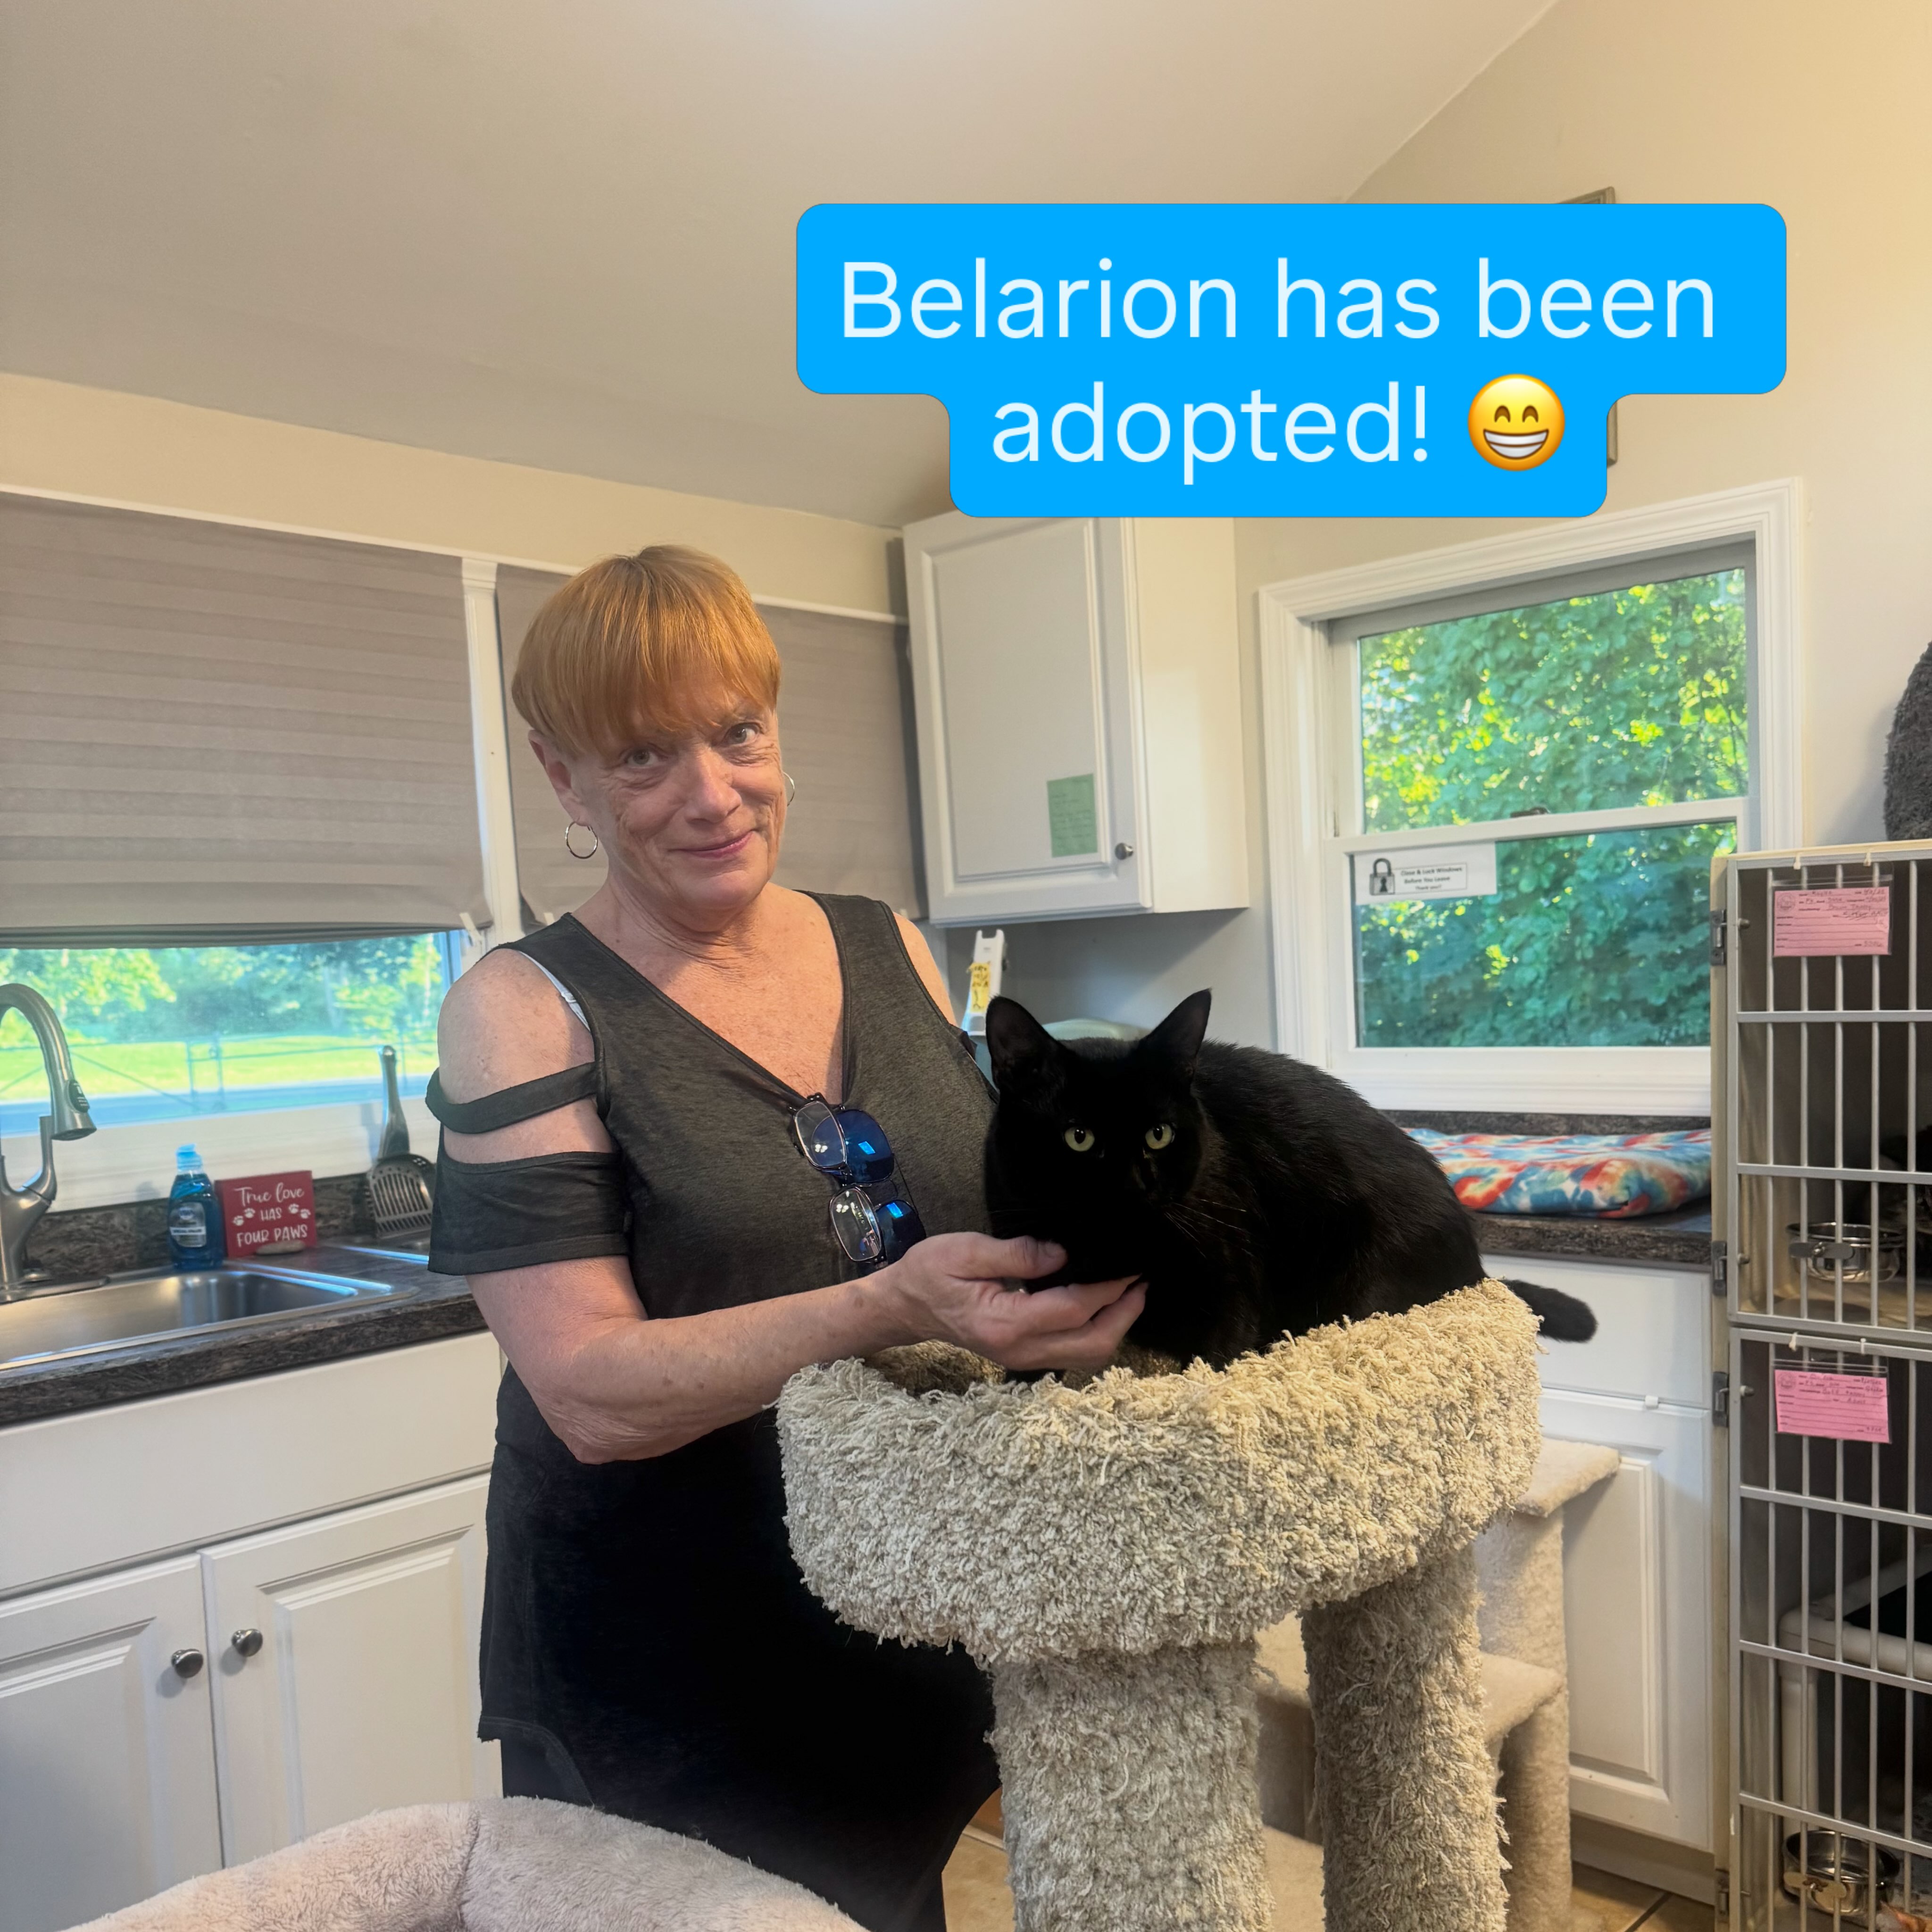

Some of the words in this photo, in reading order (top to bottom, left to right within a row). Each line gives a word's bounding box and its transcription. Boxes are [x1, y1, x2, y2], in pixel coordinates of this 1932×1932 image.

[234, 1186, 272, 1207] True
[275, 1182, 305, 1203] love
[260, 1207, 282, 1221] HAS
[237, 1230, 269, 1247] FOUR
[274, 1224, 308, 1242] PAWS
